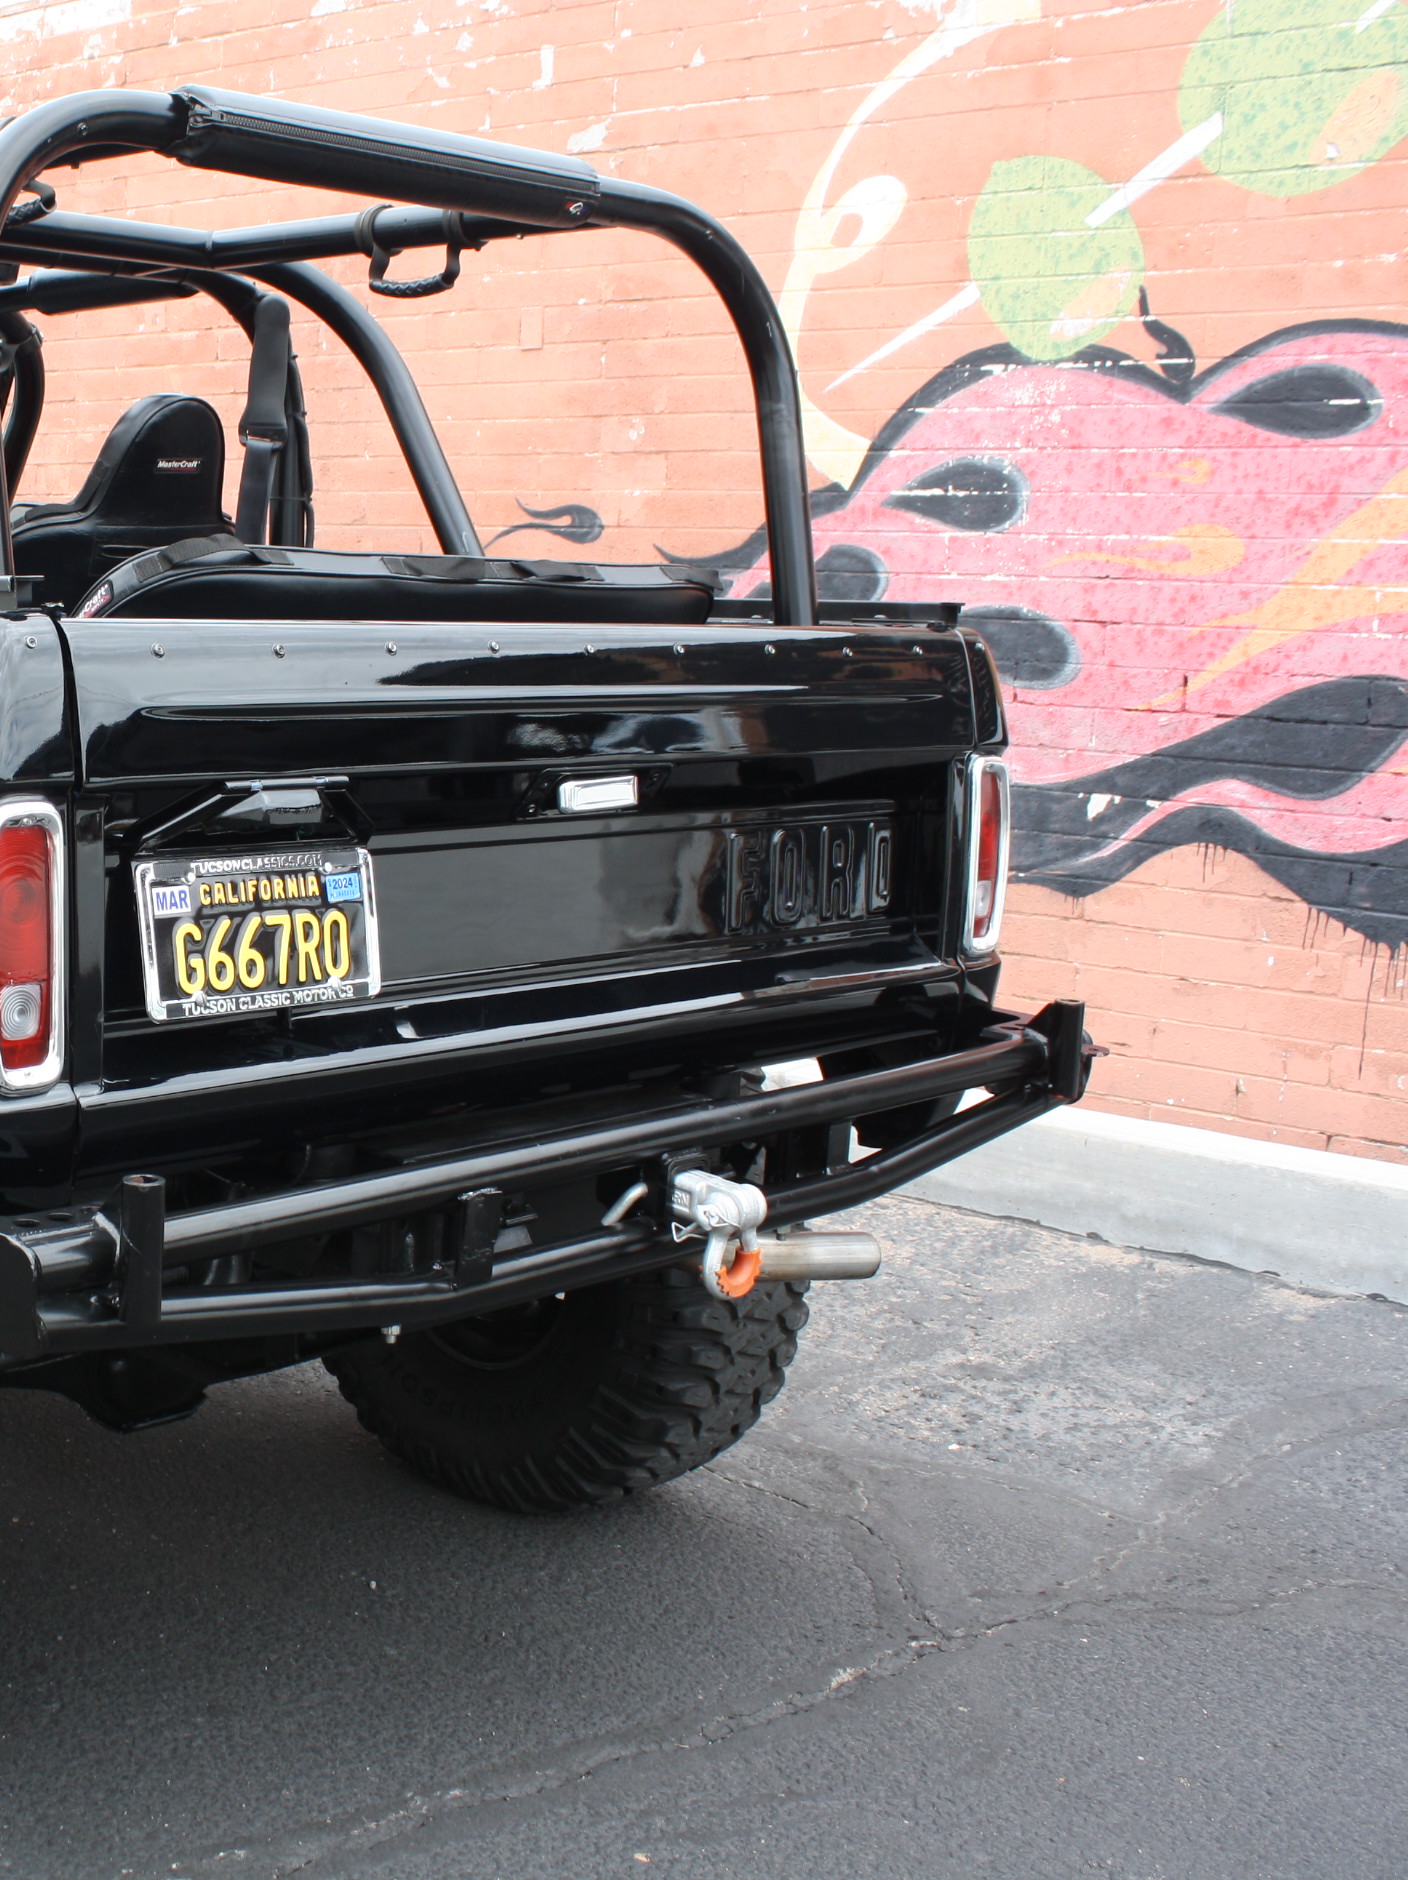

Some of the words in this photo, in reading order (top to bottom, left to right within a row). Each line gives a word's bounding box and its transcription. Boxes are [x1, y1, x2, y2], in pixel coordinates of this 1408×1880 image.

[157, 460, 198, 469] MasterCraft
[199, 875, 321, 906] CALIFORNIA
[333, 876, 353, 890] 2024
[724, 821, 892, 935] FORD
[155, 889, 189, 912] MAR
[182, 998, 236, 1017] TUCSON
[239, 991, 290, 1010] CLASSIC
[293, 987, 336, 1004] MOTOR
